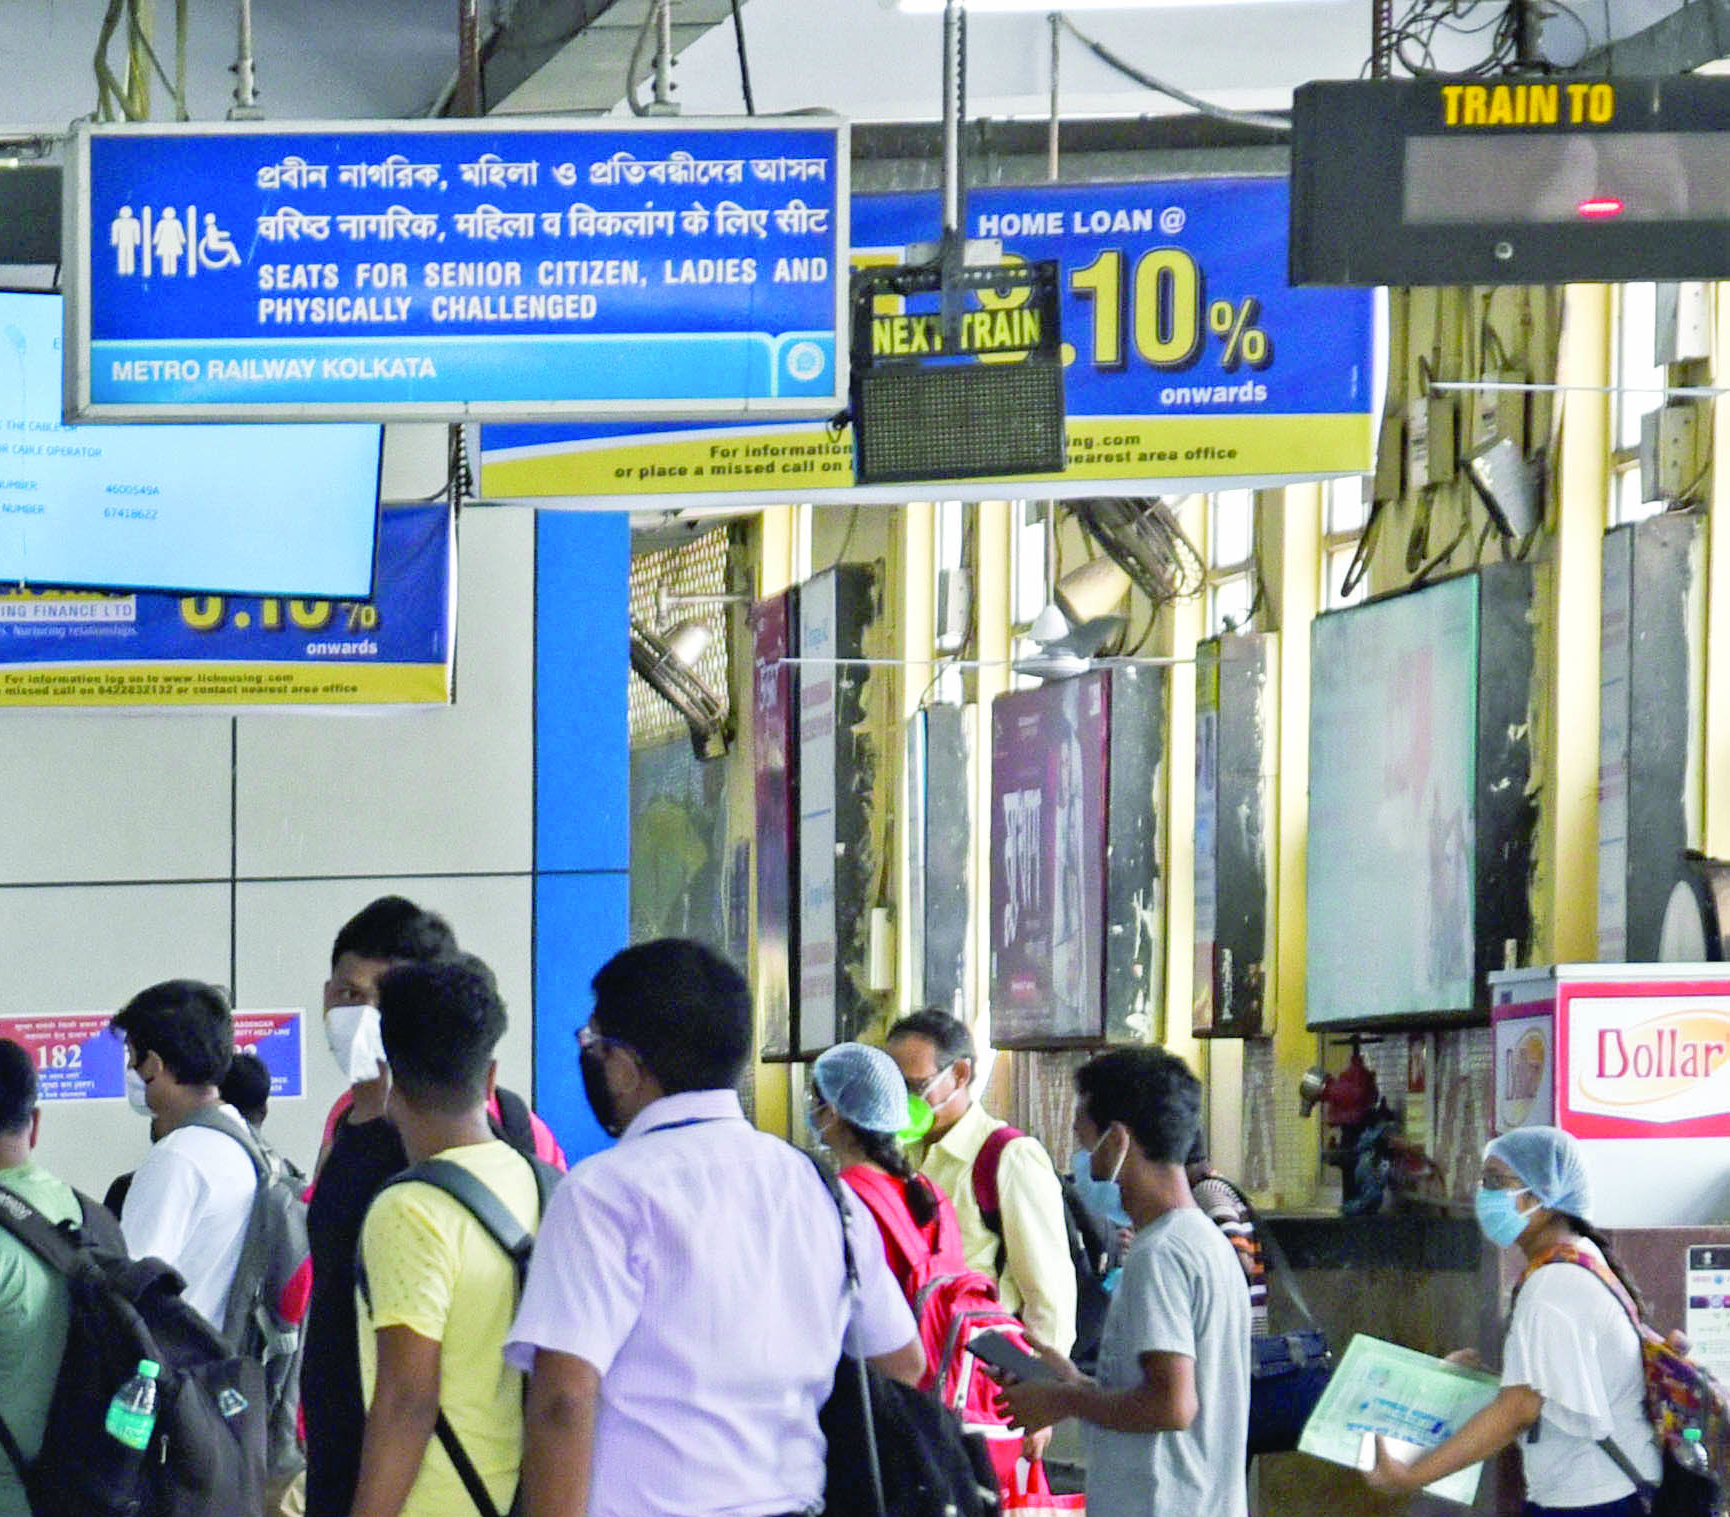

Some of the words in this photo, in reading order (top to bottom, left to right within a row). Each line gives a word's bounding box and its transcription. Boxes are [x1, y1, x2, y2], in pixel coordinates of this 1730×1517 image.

[1442, 84, 1559, 126] TRAIN
[1567, 83, 1615, 124] TO
[257, 156, 329, 189] প্রবীন
[338, 154, 448, 191] নাগরিক,
[460, 153, 539, 189] মহিলা
[552, 162, 578, 187] ও
[589, 151, 745, 185] প্রতিবন্ধীদের
[749, 157, 828, 182] আসন
[257, 206, 331, 241] वरिष्ठ
[337, 204, 446, 243] नागरिक,
[454, 203, 535, 240] महिला
[541, 212, 562, 237] व
[568, 201, 676, 237] विकलांग
[680, 200, 710, 236] के
[715, 200, 769, 239] लिए
[773, 198, 829, 235] सीट
[979, 212, 1065, 237] HOME
[1073, 208, 1153, 234] LOAN
[1160, 206, 1186, 235] @
[258, 263, 339, 290] SEATS
[356, 262, 408, 288] FOR
[424, 261, 522, 288] SENIOR
[538, 259, 647, 288] CITIZEN,
[664, 258, 757, 284] LADIES
[774, 257, 828, 283] AND
[259, 296, 412, 323] PHYSICALLY
[432, 294, 597, 321] CHALLENGED
[111, 360, 200, 382] METRO
[207, 358, 316, 381] RAILWAY
[322, 356, 438, 379] KOLKATA
[1160, 380, 1268, 406] onwards
[46, 445, 102, 458] OPERATOR
[614, 466, 632, 479] or
[639, 464, 688, 481] place
[693, 466, 704, 476] a
[711, 461, 775, 477] missed
[782, 461, 814, 474] call
[821, 461, 842, 472] on
[1137, 448, 1178, 462] area
[1185, 445, 1237, 461] office
[710, 446, 737, 459] For
[34, 604, 98, 617] FINANCE
[105, 603, 133, 617] LTD
[306, 640, 378, 655] onwards
[5, 675, 24, 684] For
[28, 673, 101, 684] information
[37, 1044, 82, 1069] 182
[1596, 1028, 1725, 1079] Dollar
